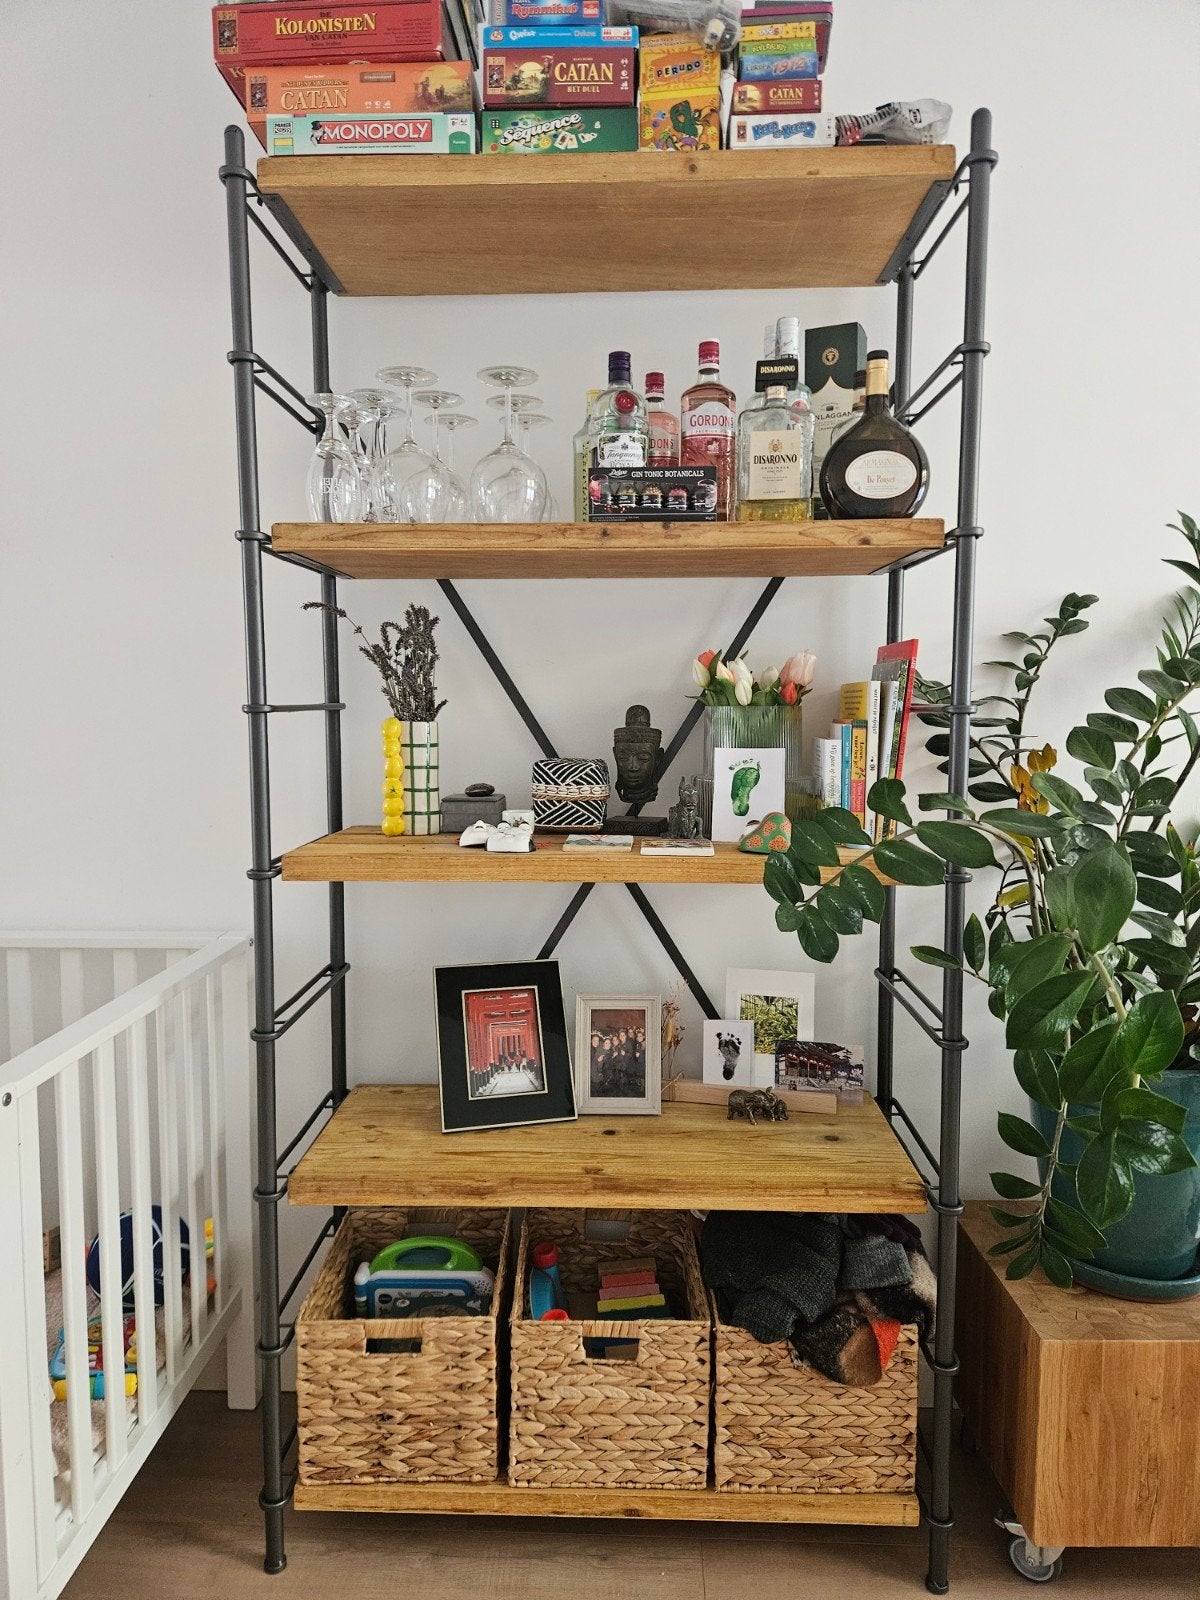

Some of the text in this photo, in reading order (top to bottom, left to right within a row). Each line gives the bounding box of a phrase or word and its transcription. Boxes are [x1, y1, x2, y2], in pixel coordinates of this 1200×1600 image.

[511, 3, 579, 19] Rummikub
[274, 13, 378, 36] KOLONISTEN
[321, 33, 348, 41] CATAN
[554, 62, 614, 82] CATAN
[657, 60, 701, 77] PERUDO
[772, 57, 805, 75] 1912
[582, 85, 600, 93] DUEL
[769, 87, 803, 99] CATAN
[280, 89, 349, 111] CATAN
[323, 122, 428, 140] MONOPOLY
[500, 113, 582, 145] Sequence
[760, 364, 796, 374] DISARONNO
[814, 411, 852, 421] NLAGGAN
[753, 453, 798, 465] DISARONNO
[644, 470, 663, 478] TONIC
[664, 469, 705, 478] BOTANICALS
